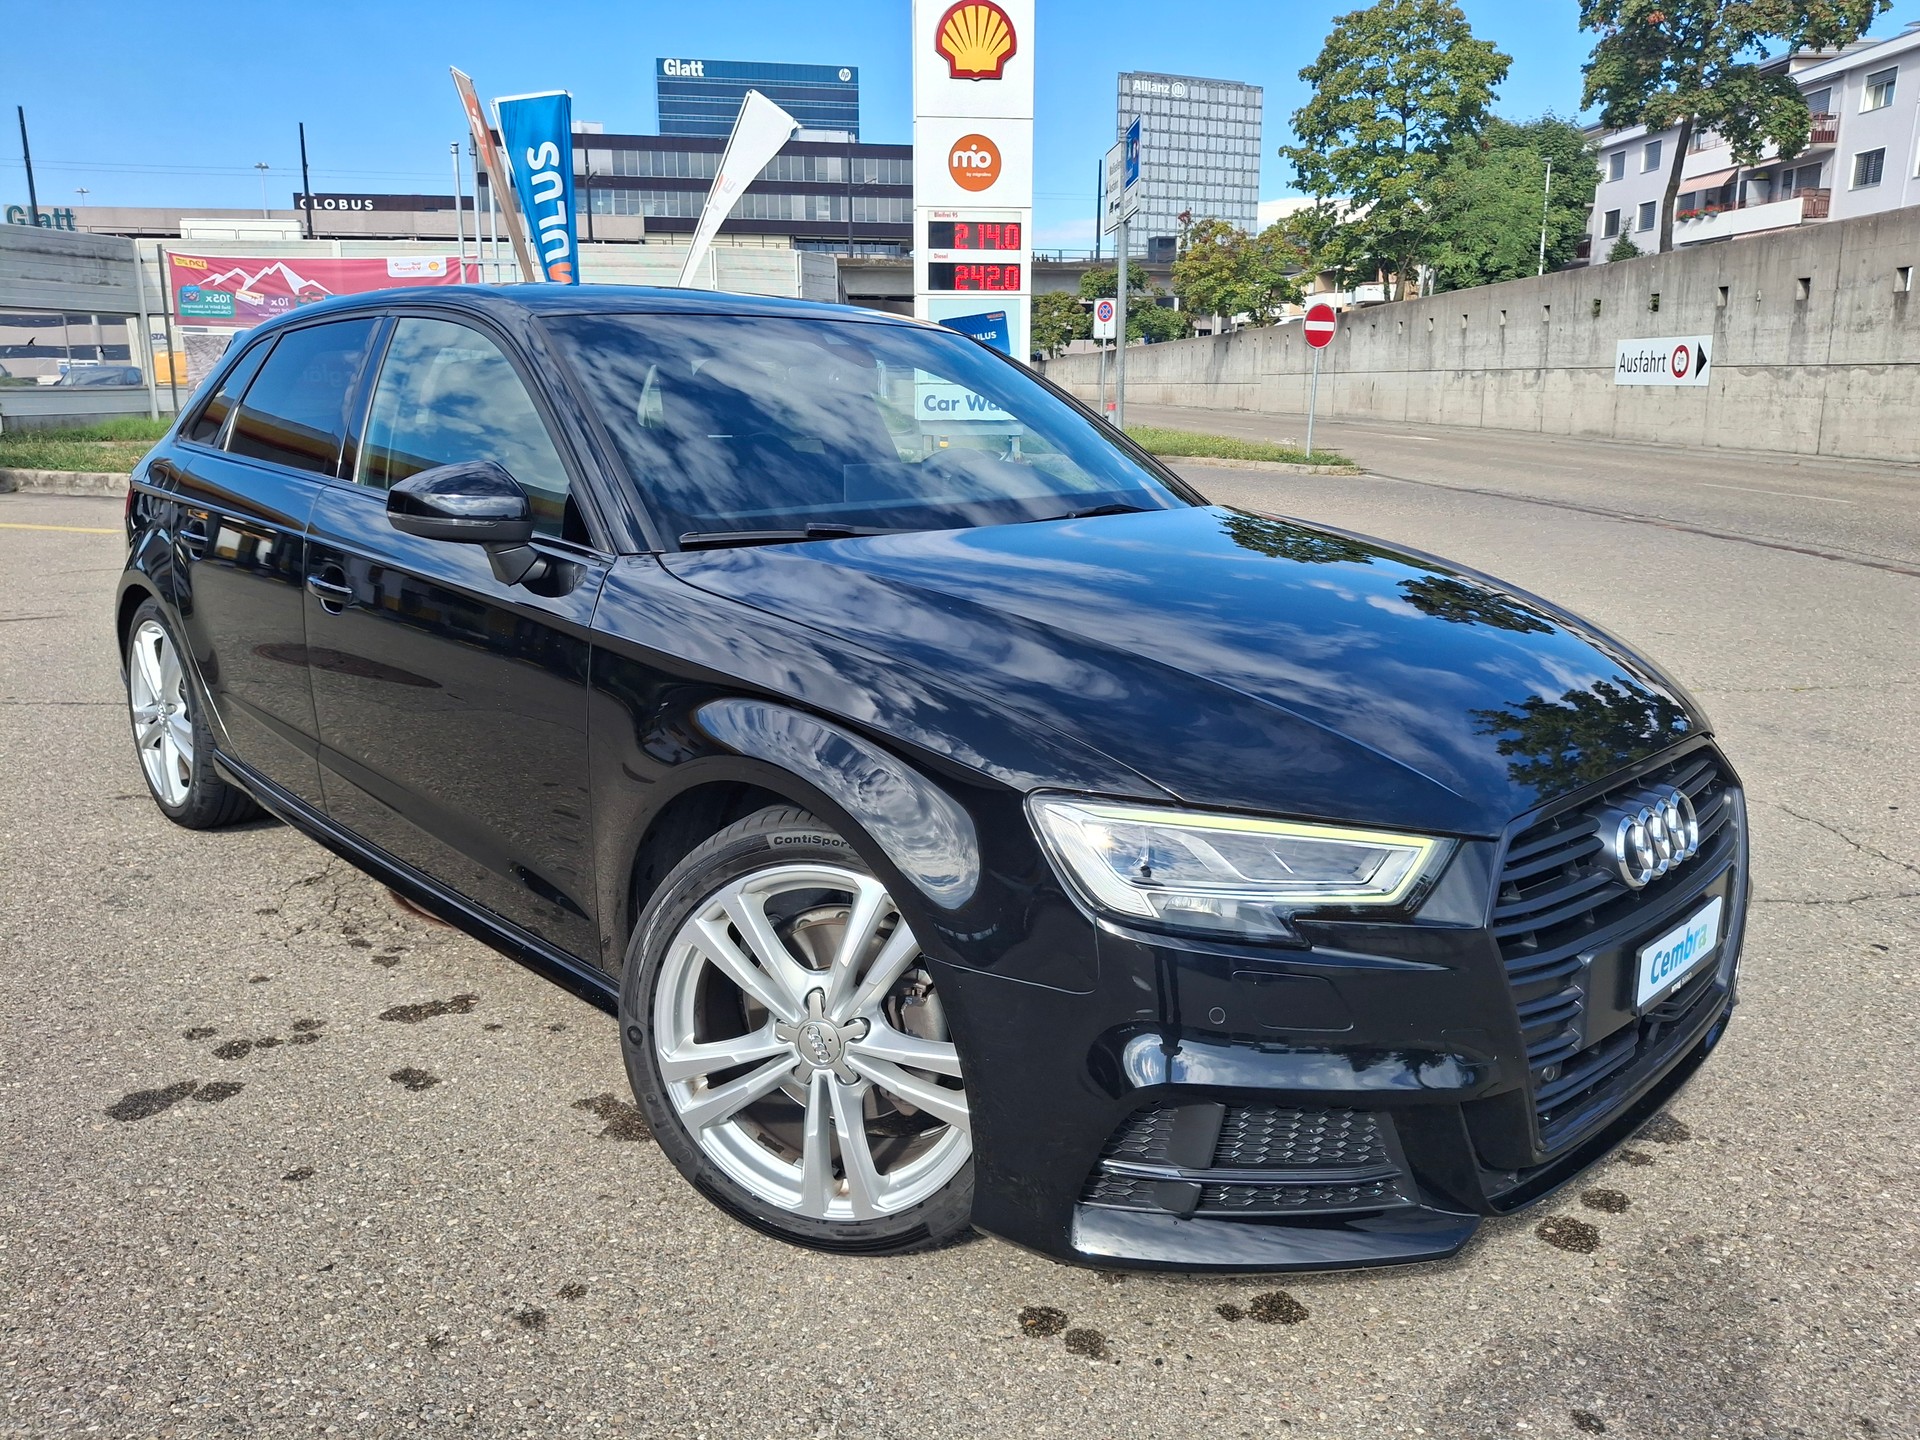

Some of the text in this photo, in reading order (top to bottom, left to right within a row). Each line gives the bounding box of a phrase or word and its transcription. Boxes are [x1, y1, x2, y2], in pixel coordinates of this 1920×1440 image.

[663, 59, 704, 76] Glatt
[1132, 80, 1170, 93] Allianz
[953, 144, 992, 168] mio
[7, 205, 75, 231] Glatt
[955, 265, 1019, 290] 242.0
[972, 331, 997, 341] ULUS
[1618, 350, 1667, 373] Ausfahrt
[924, 395, 960, 411] Car
[1650, 923, 1708, 985] Cembra
